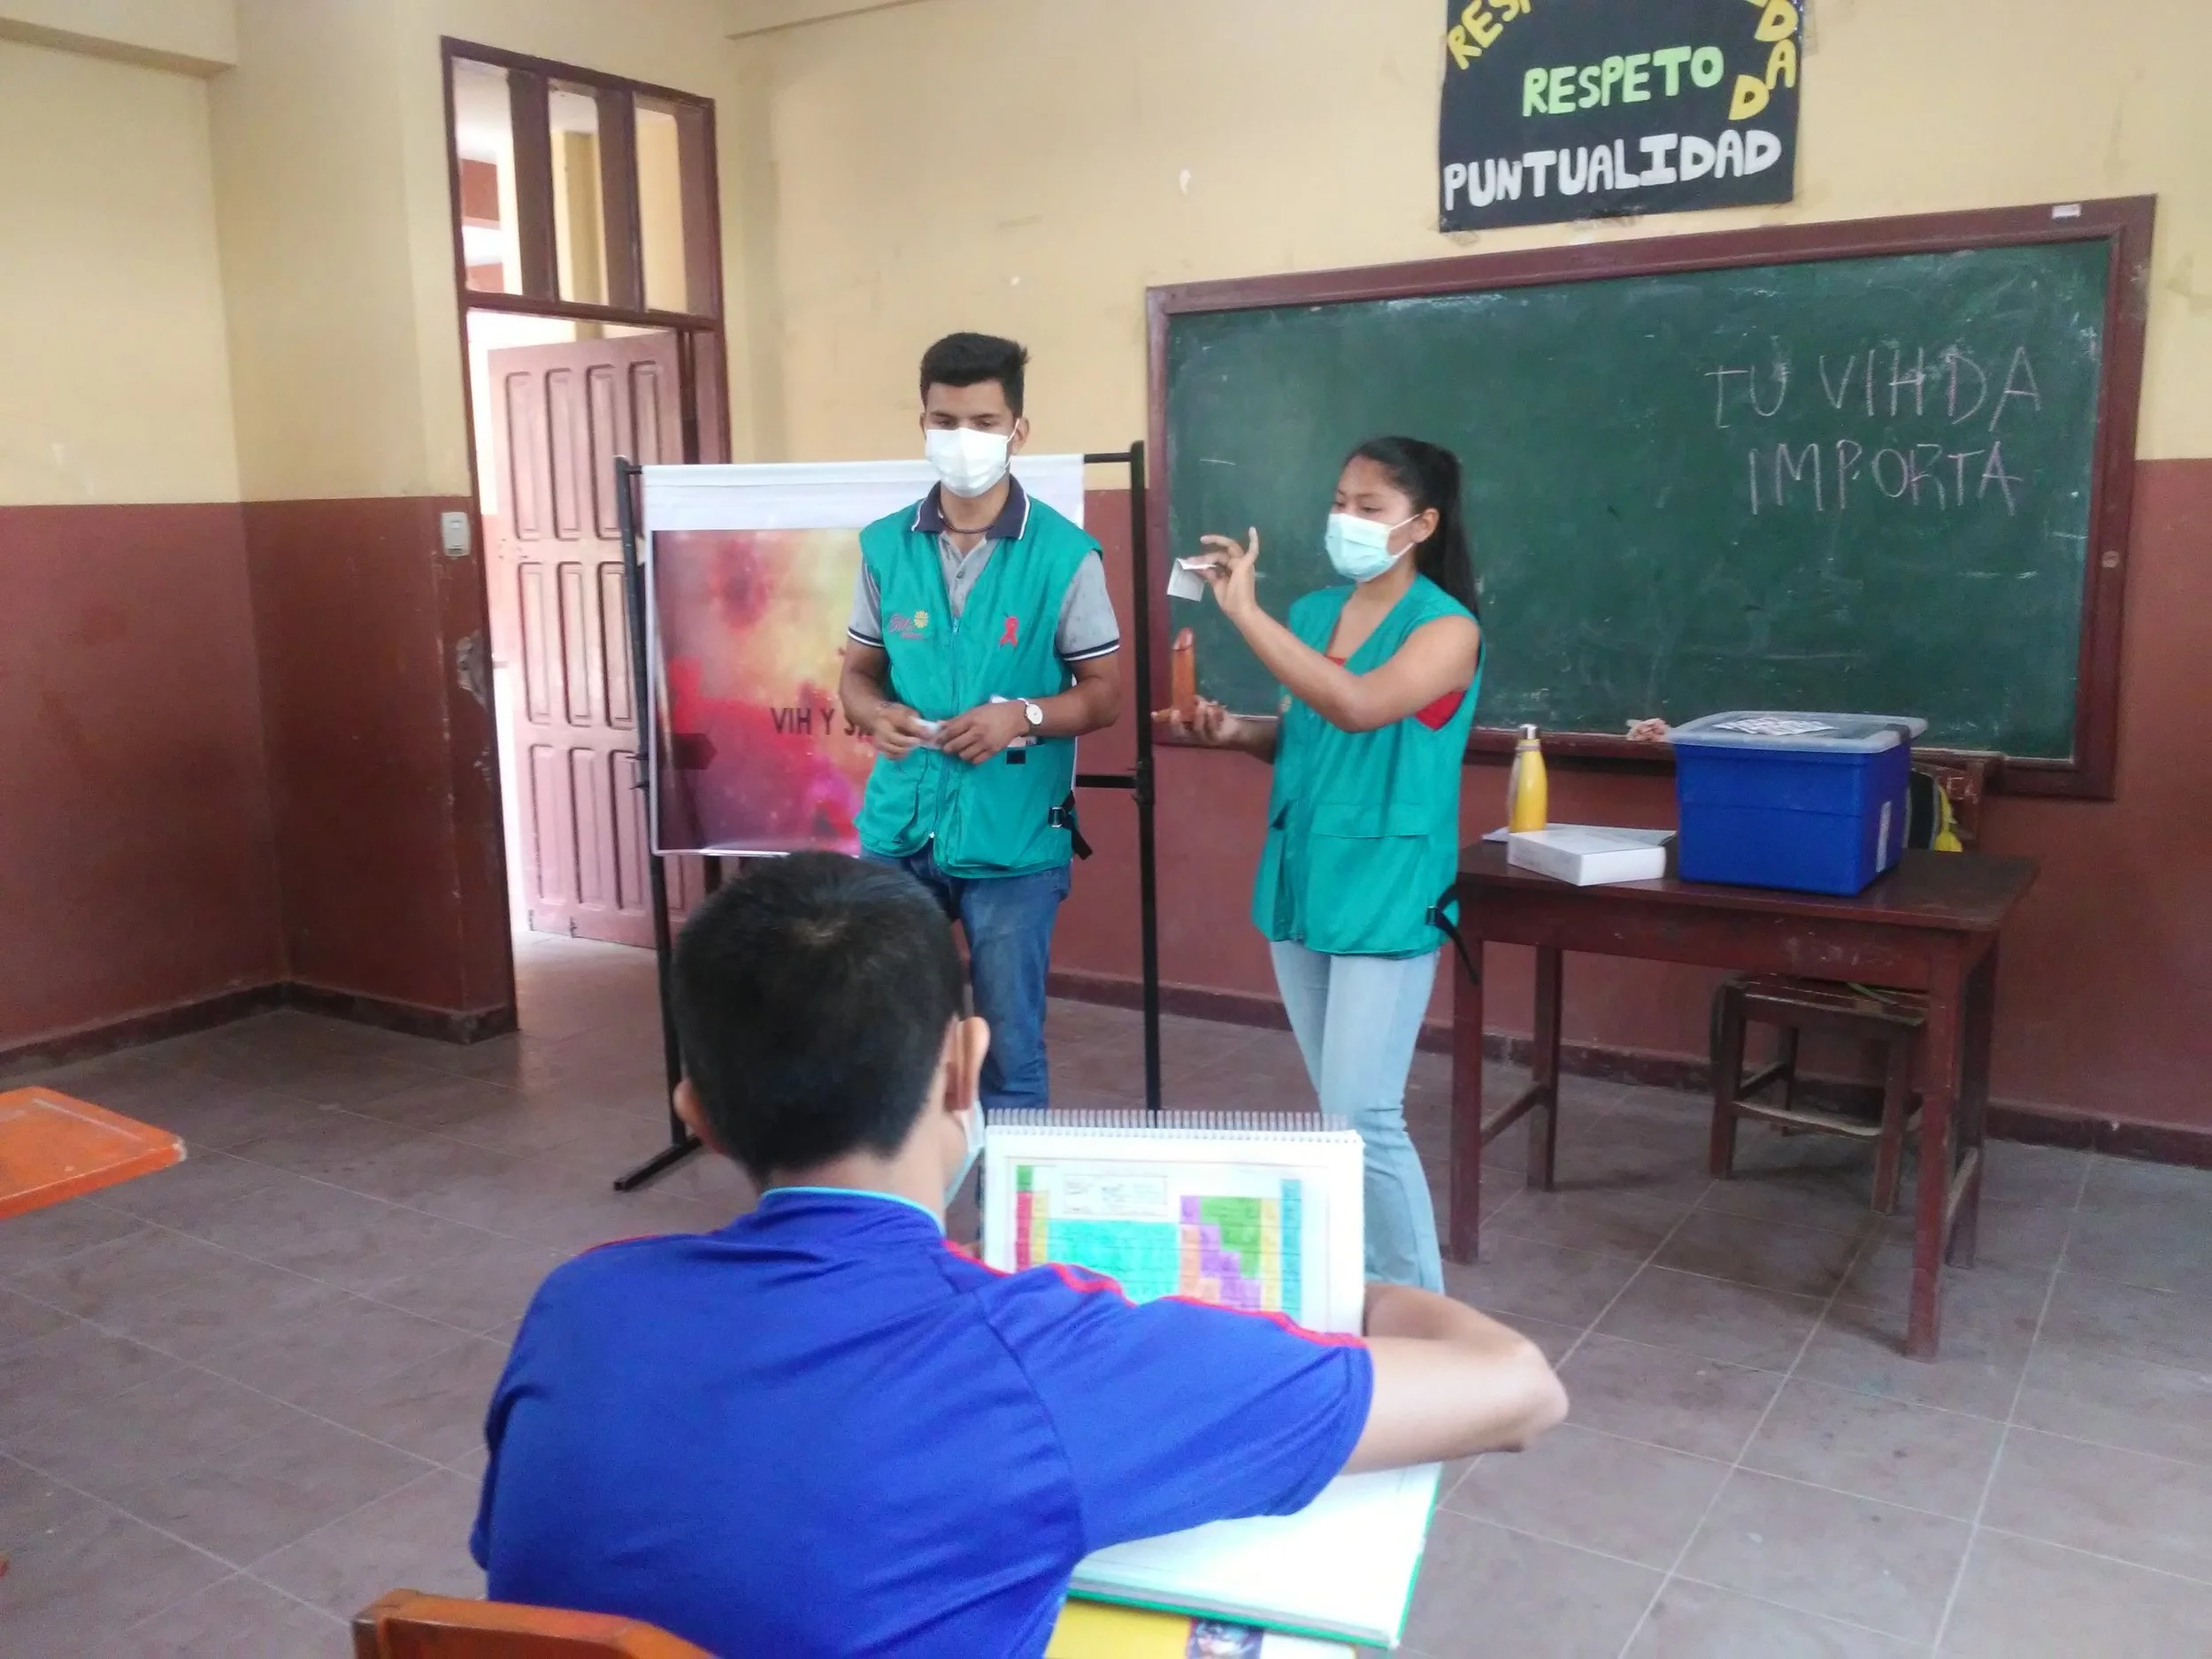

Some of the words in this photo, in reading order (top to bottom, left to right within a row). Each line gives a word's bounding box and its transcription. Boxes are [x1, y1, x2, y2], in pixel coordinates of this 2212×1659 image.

[1522, 46, 1724, 117] RESPETO
[1444, 129, 1782, 211] PUNTUALIDAD
[1704, 363, 1788, 429] TU
[1819, 346, 2041, 432] VIHDA
[1748, 439, 2024, 516] IMPORTA
[770, 707, 811, 735] VIH
[820, 708, 834, 735] Y
